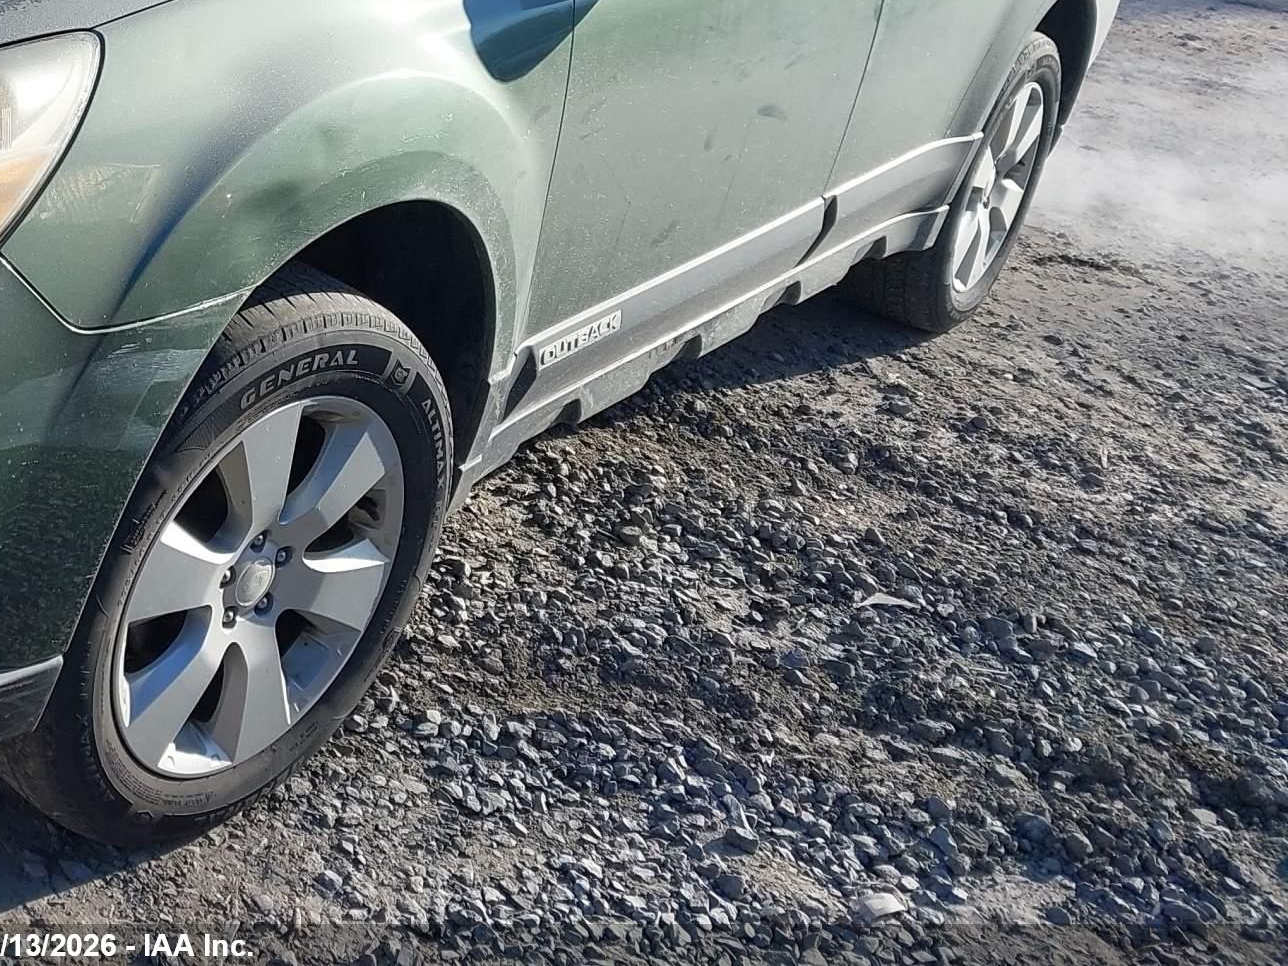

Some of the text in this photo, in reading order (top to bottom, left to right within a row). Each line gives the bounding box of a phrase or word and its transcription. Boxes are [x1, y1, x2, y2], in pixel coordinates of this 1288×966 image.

[540, 312, 620, 367] OUTBACK
[239, 349, 360, 411] GENERAL
[421, 398, 445, 489] ALTIMAX
